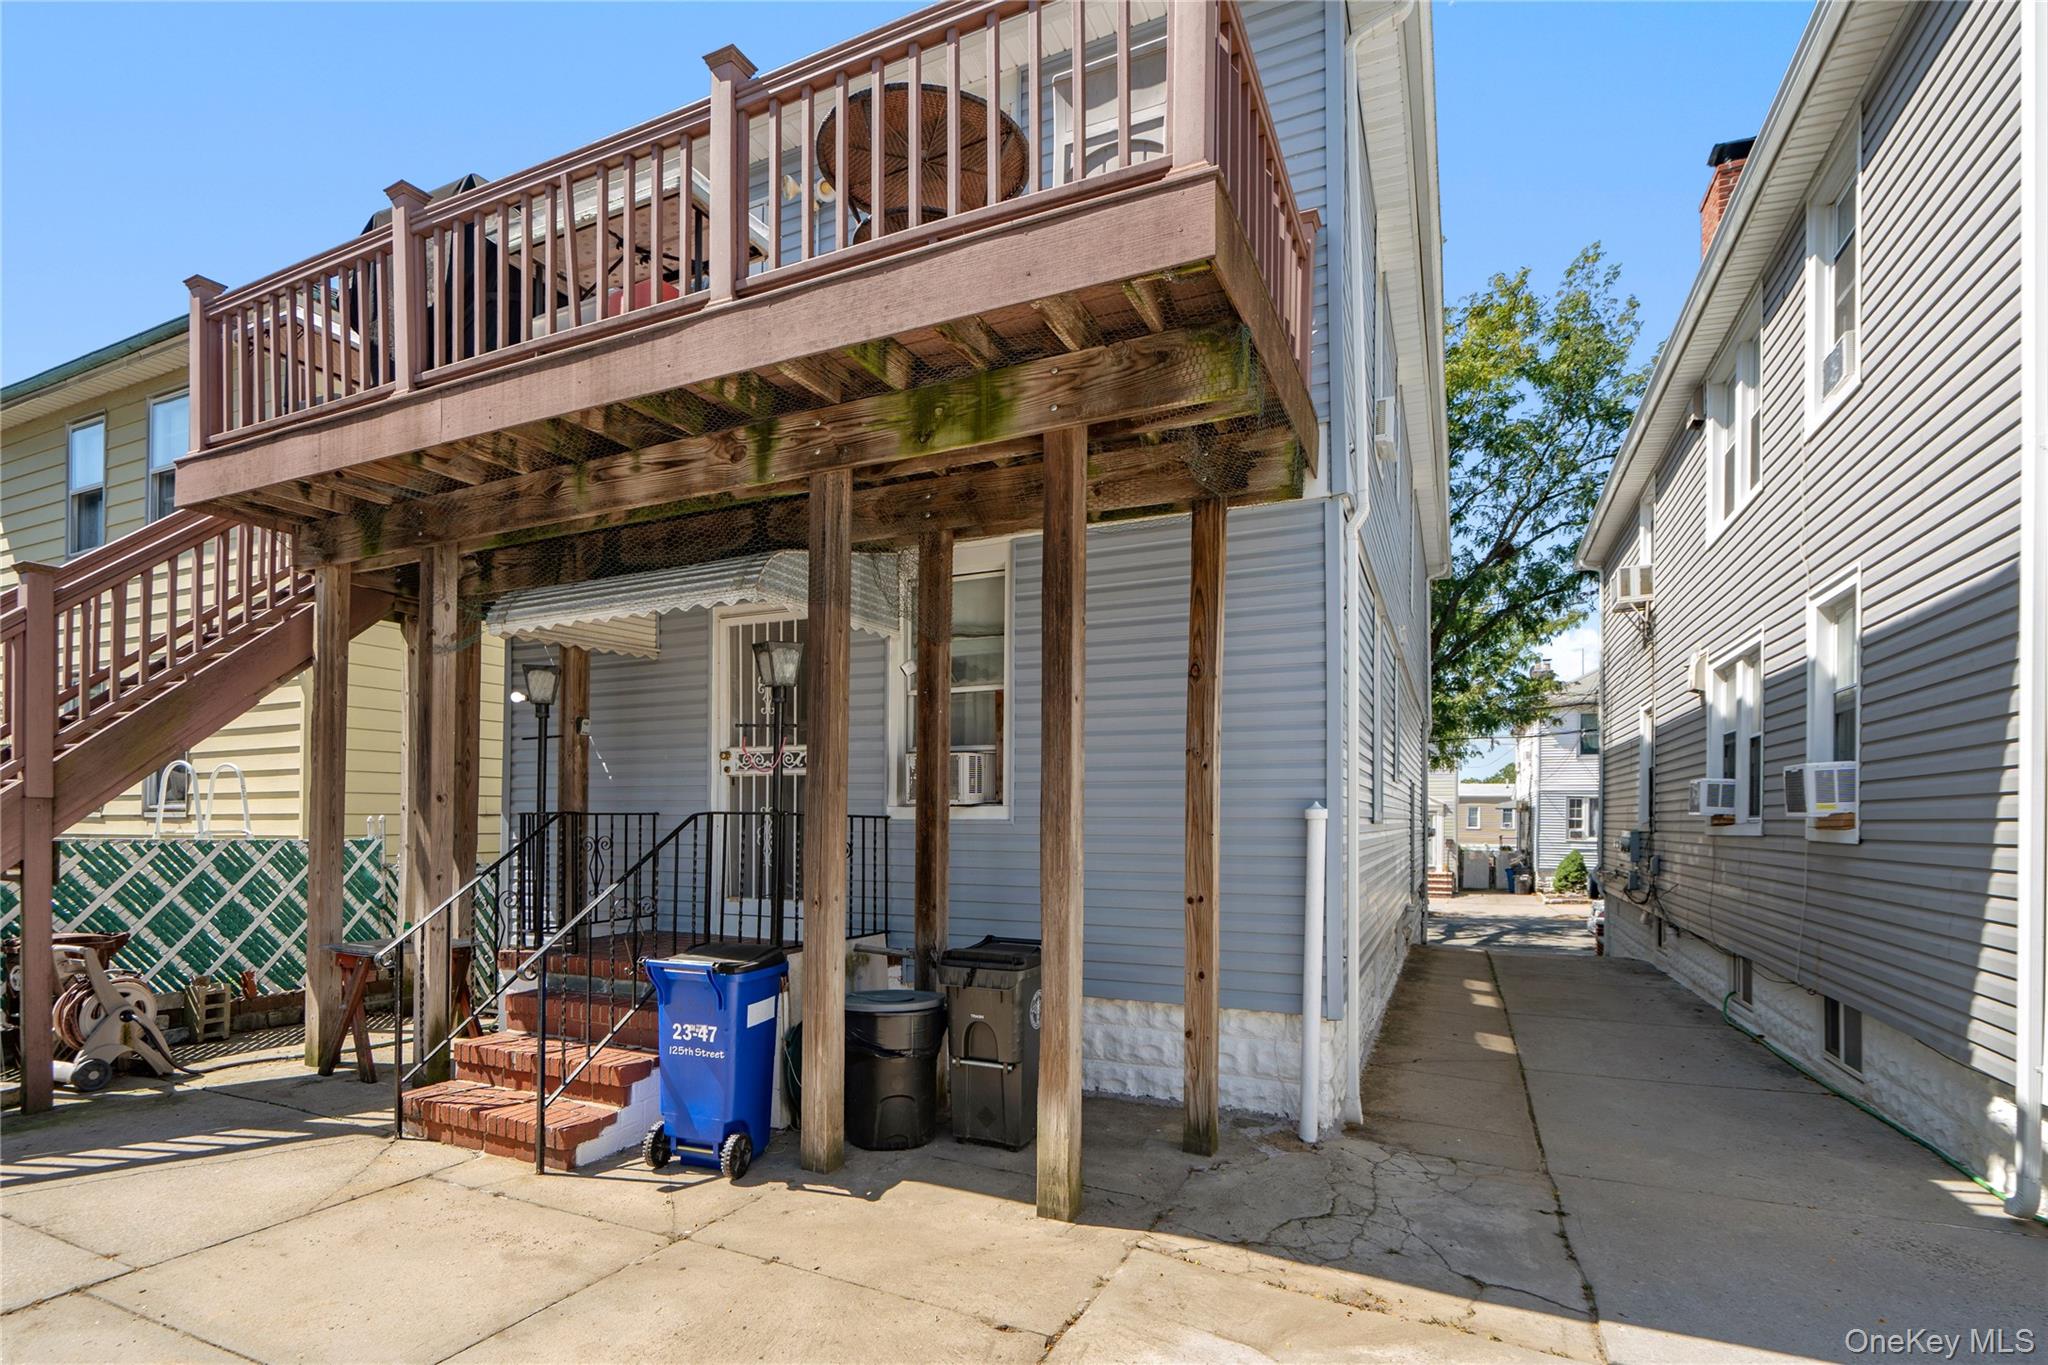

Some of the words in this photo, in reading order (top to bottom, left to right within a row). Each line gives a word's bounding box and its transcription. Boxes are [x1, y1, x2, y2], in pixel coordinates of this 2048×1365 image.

[672, 1023, 718, 1043] 23-47
[669, 1045, 694, 1056] 125th
[694, 1047, 725, 1059] Street
